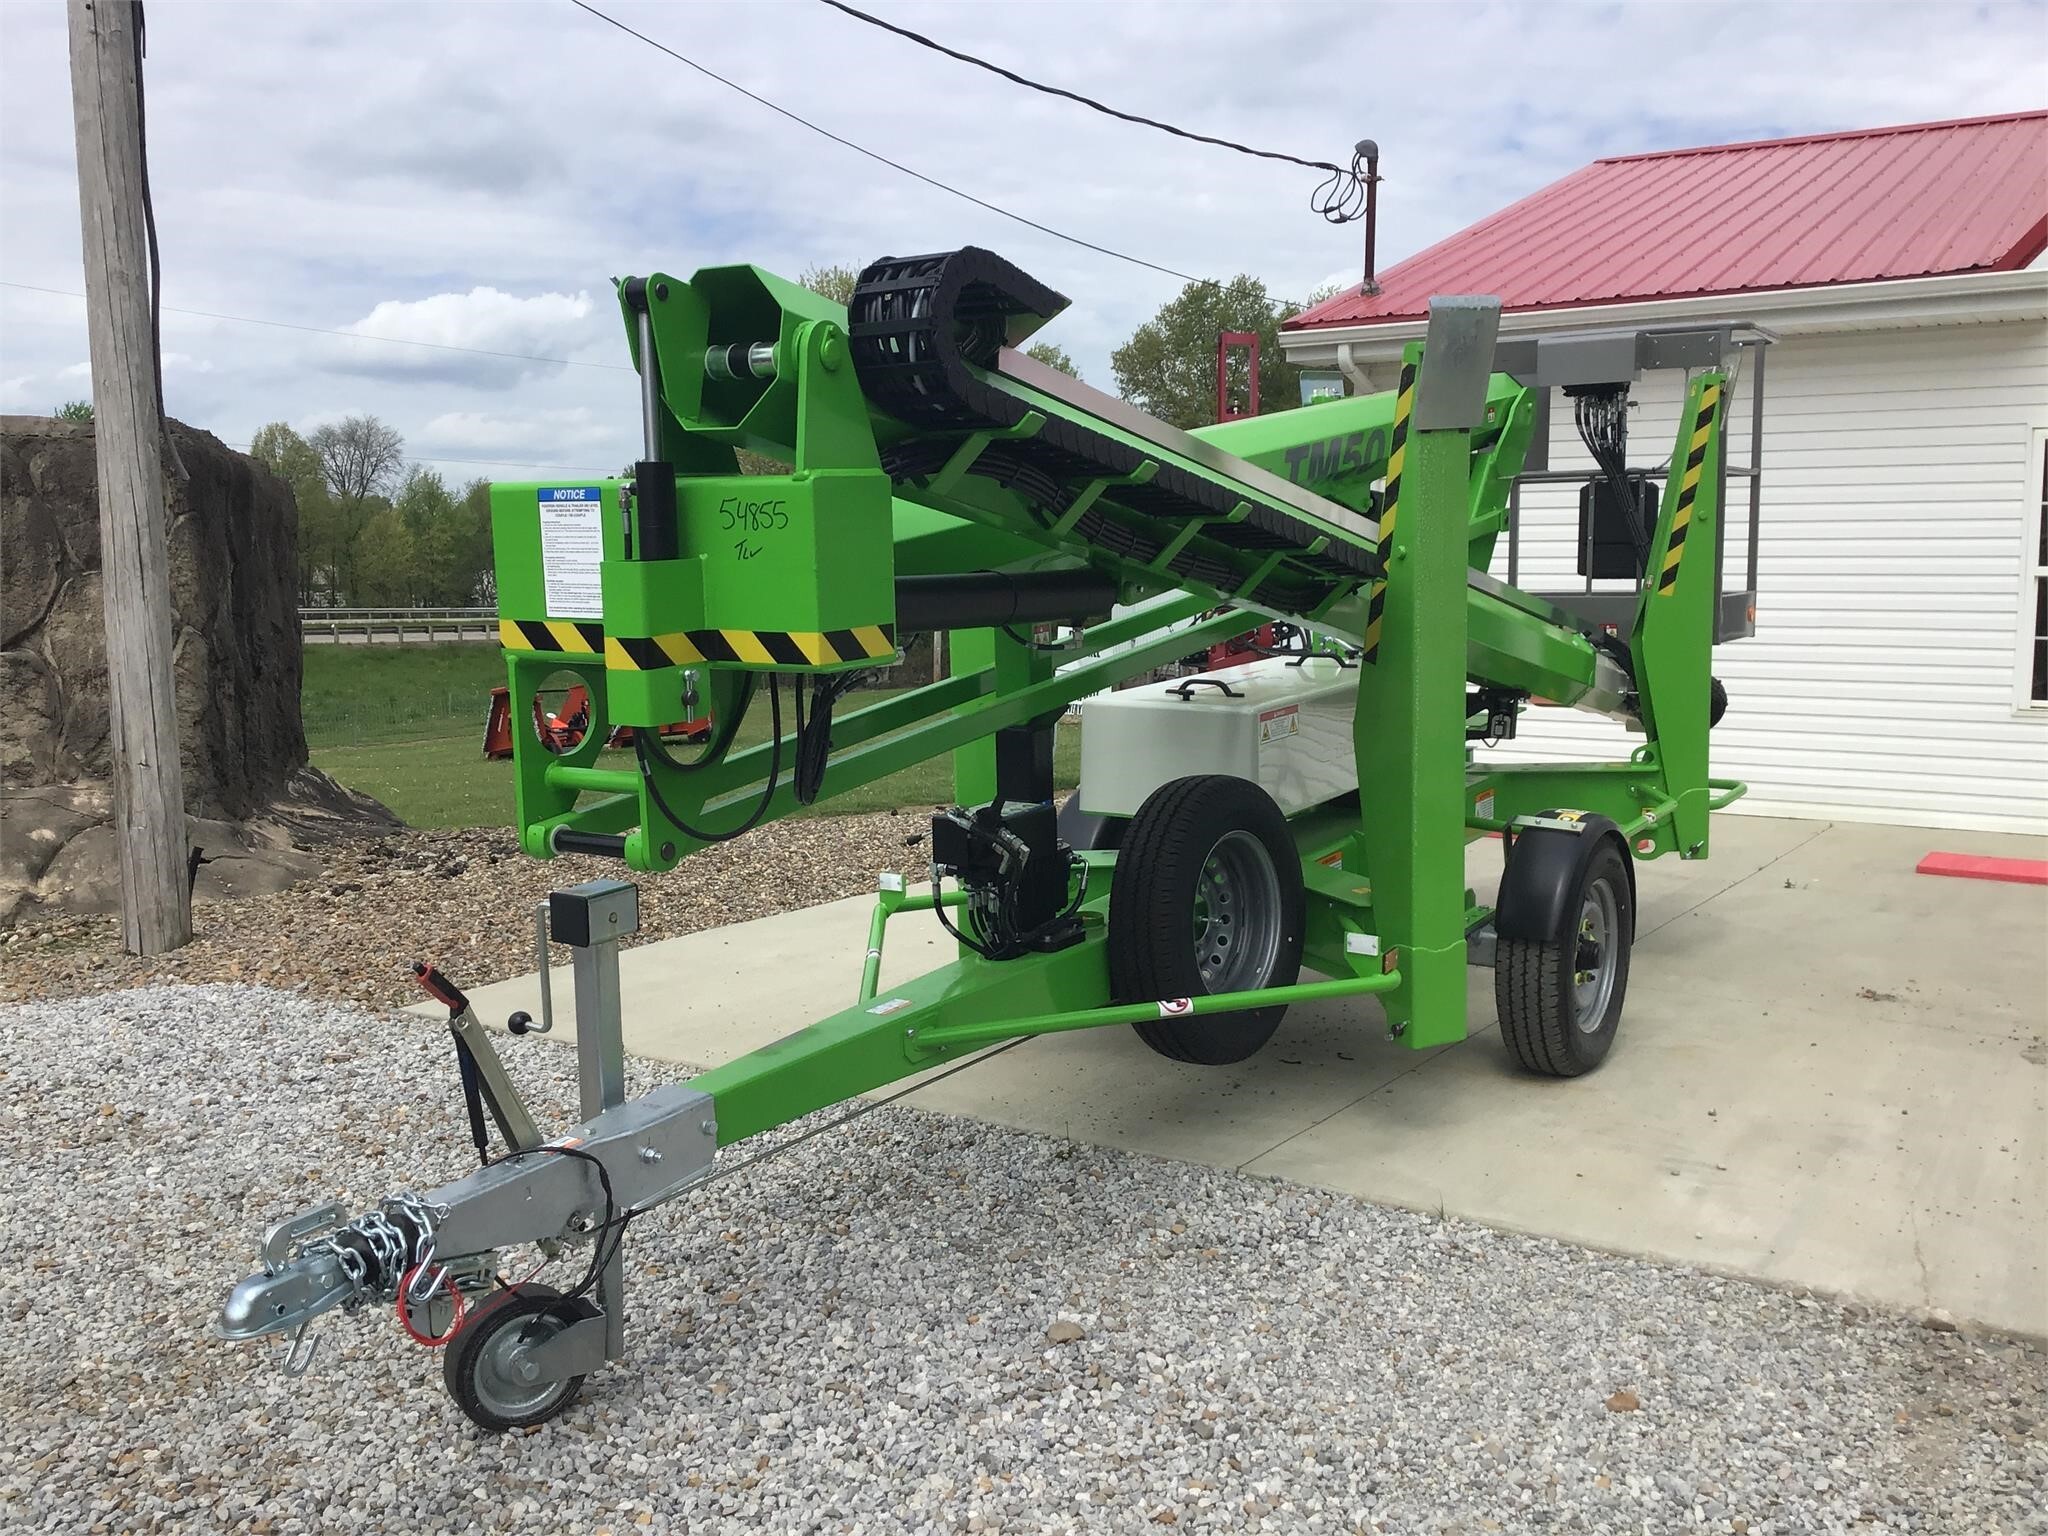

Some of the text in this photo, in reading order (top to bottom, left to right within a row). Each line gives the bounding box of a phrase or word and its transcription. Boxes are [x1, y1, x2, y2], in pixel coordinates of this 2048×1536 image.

[1285, 428, 1386, 483] TM50
[553, 489, 586, 500] NOTICE
[719, 497, 789, 531] 54855
